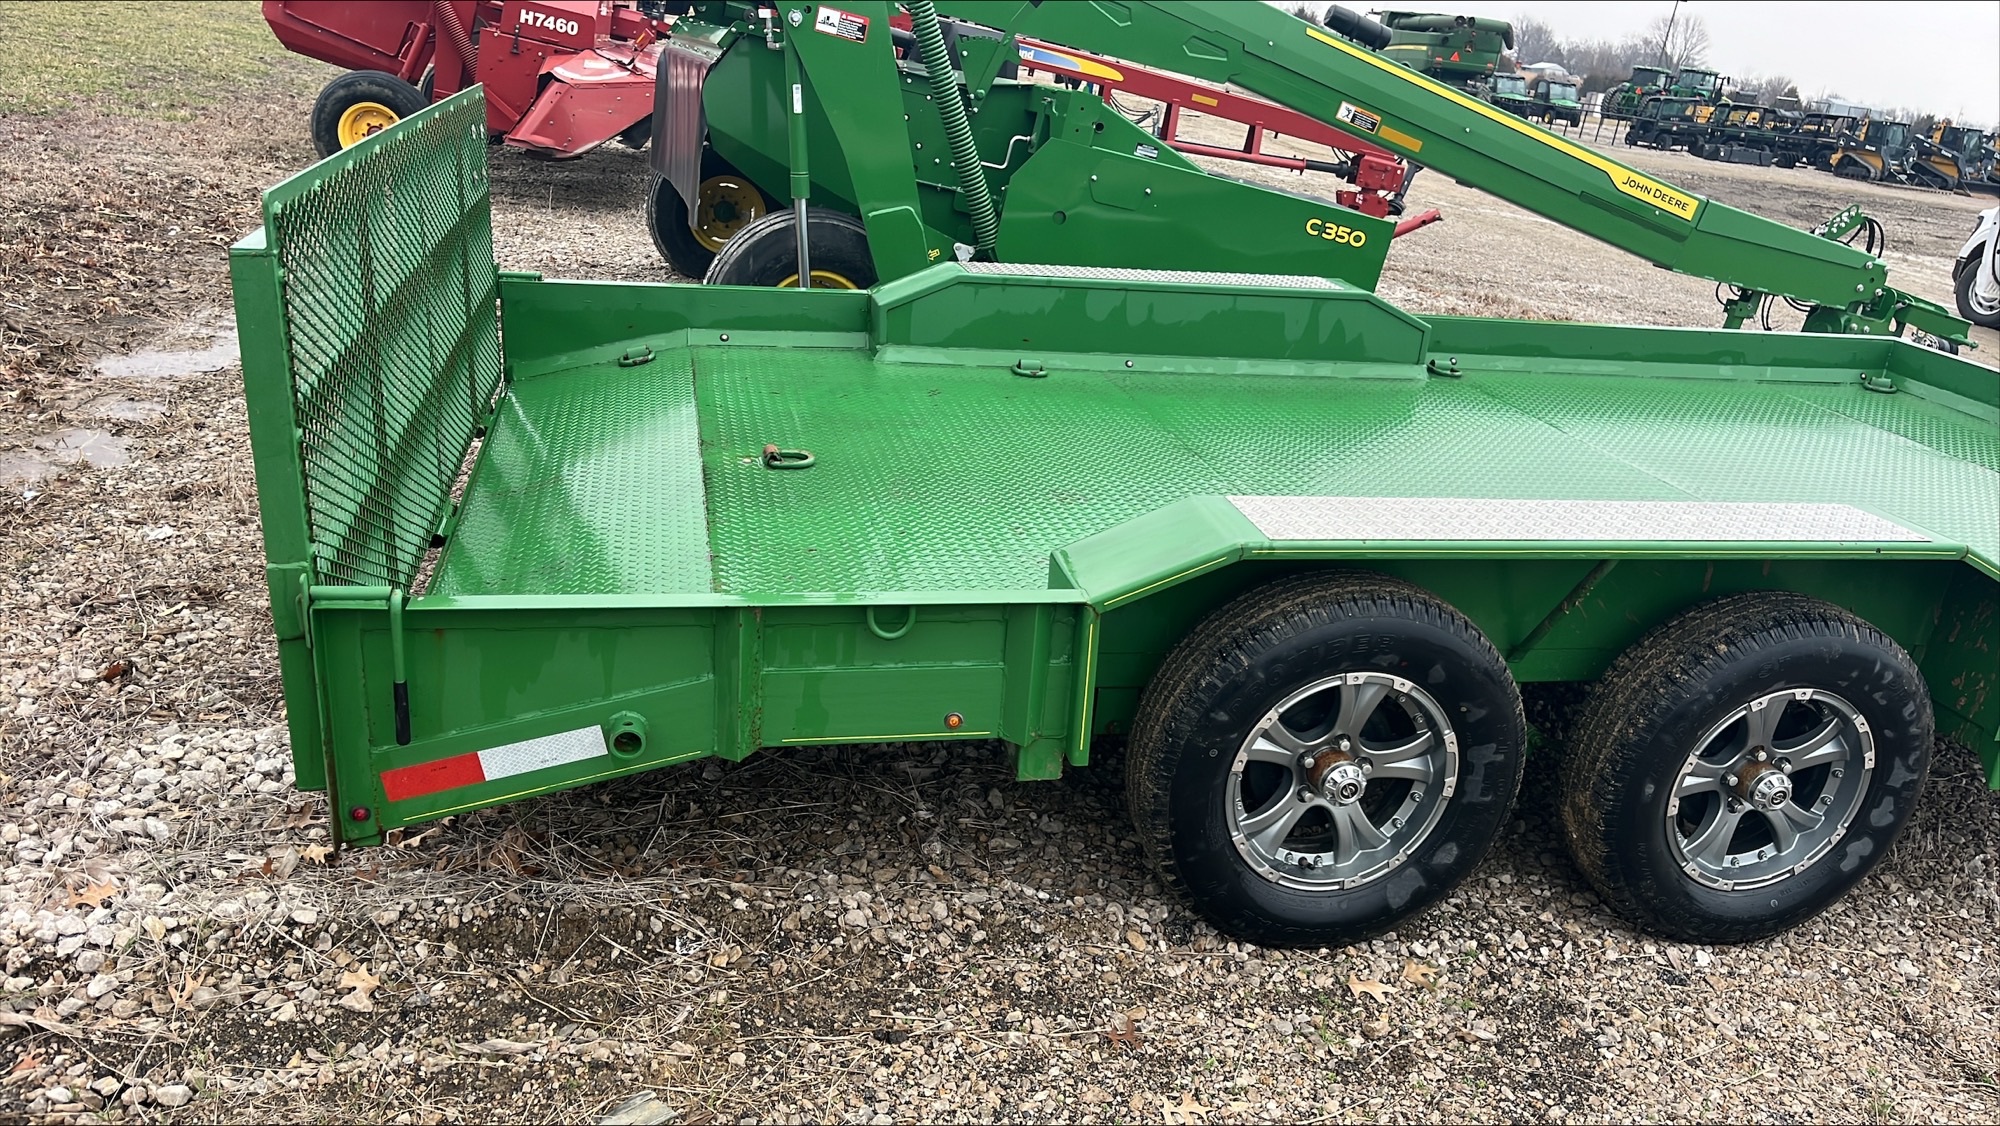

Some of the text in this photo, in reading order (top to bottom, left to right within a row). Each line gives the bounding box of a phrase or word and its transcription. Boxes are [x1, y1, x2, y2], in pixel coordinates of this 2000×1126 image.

[519, 9, 579, 36] H7460
[1018, 48, 1035, 60] nd
[1622, 176, 1690, 212] JOHN DEERE
